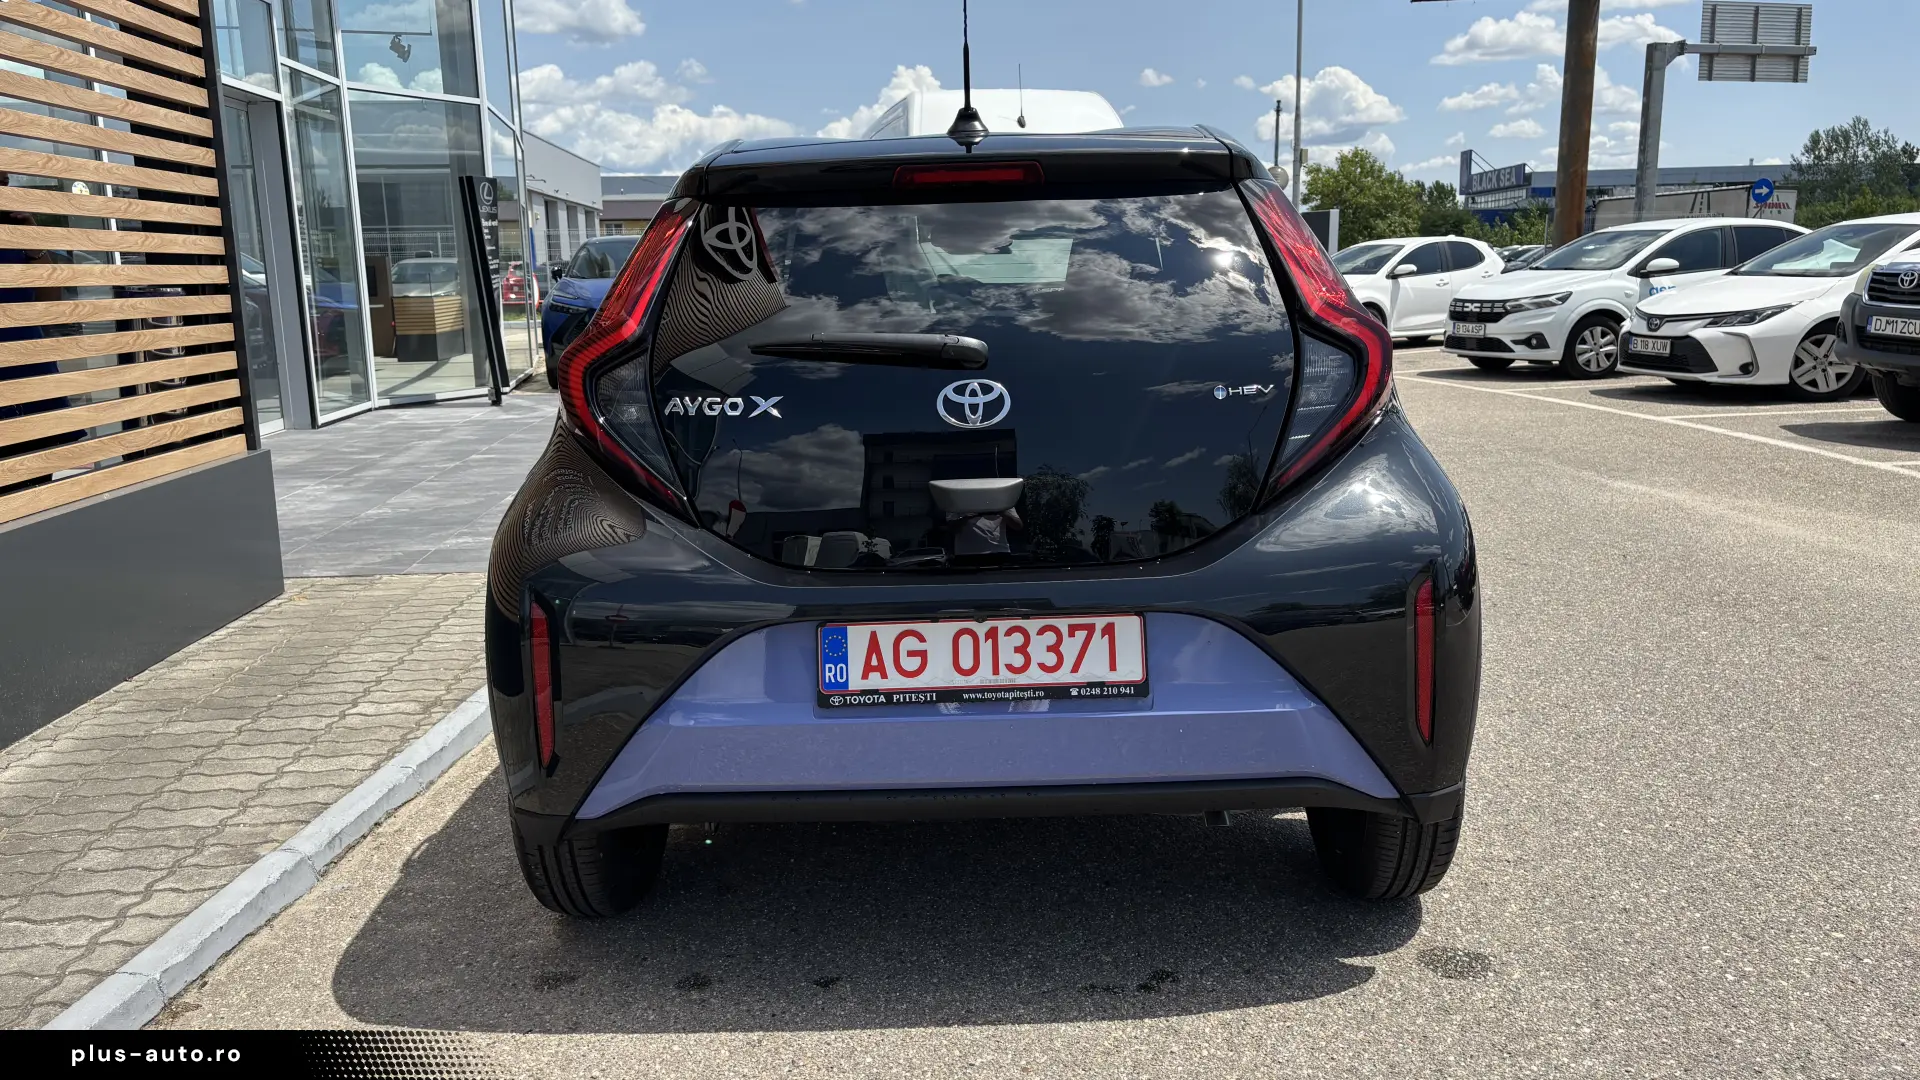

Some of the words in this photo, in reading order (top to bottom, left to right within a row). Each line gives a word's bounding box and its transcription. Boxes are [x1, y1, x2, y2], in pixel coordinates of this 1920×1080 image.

[1472, 170, 1498, 192] BLACK
[1500, 167, 1516, 186] SEA
[1471, 325, 1483, 334] ASP
[1632, 338, 1638, 349] B
[1640, 339, 1650, 351] 118
[1651, 340, 1669, 352] XUW
[1228, 384, 1274, 396] HEV
[664, 396, 744, 416] AYGO
[748, 395, 784, 419] X
[861, 628, 928, 680] AG
[952, 621, 1117, 677] 013371
[825, 663, 847, 683] RO
[1080, 687, 1101, 696] 0248
[1103, 686, 1118, 695] 210
[1119, 686, 1134, 695] 941
[845, 694, 886, 705] TOYOTA
